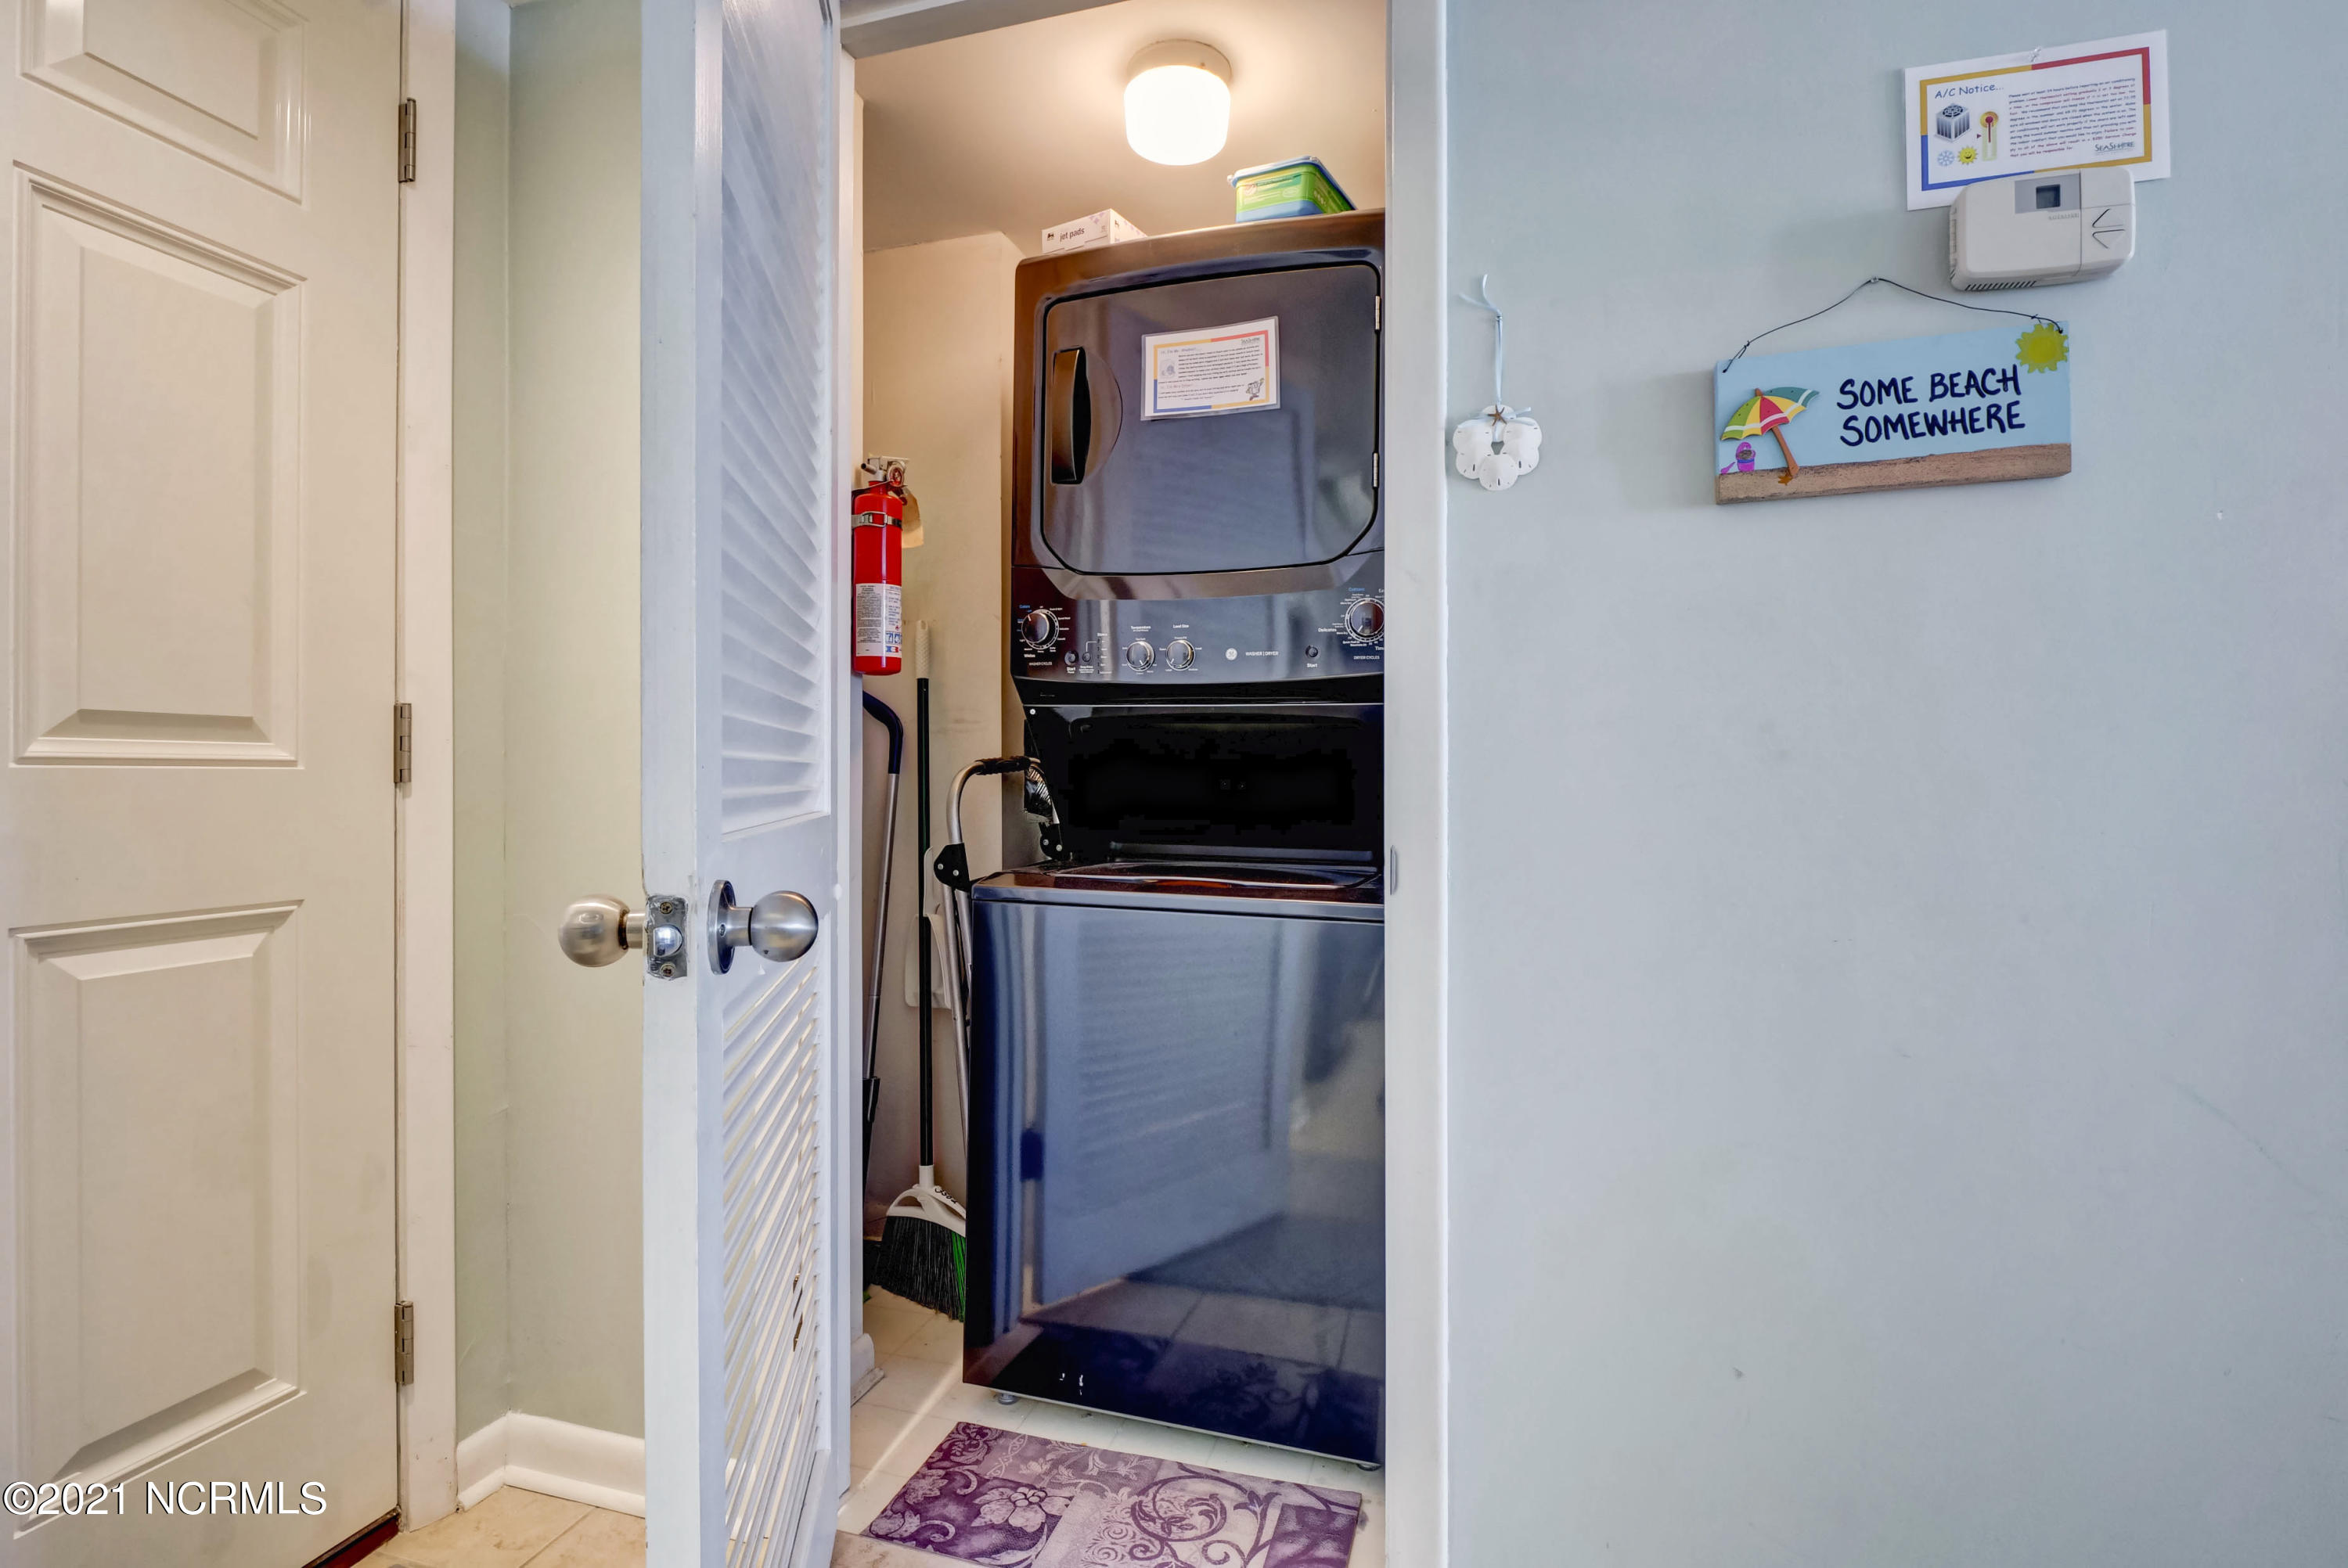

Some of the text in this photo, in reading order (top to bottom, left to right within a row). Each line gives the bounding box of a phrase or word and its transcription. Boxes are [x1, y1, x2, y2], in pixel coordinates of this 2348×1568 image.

[1935, 88, 1956, 99] A/C
[1069, 228, 1085, 239] pads
[1837, 364, 2022, 410] SOME BEACH
[1840, 400, 2026, 447] SOMEWHERE
